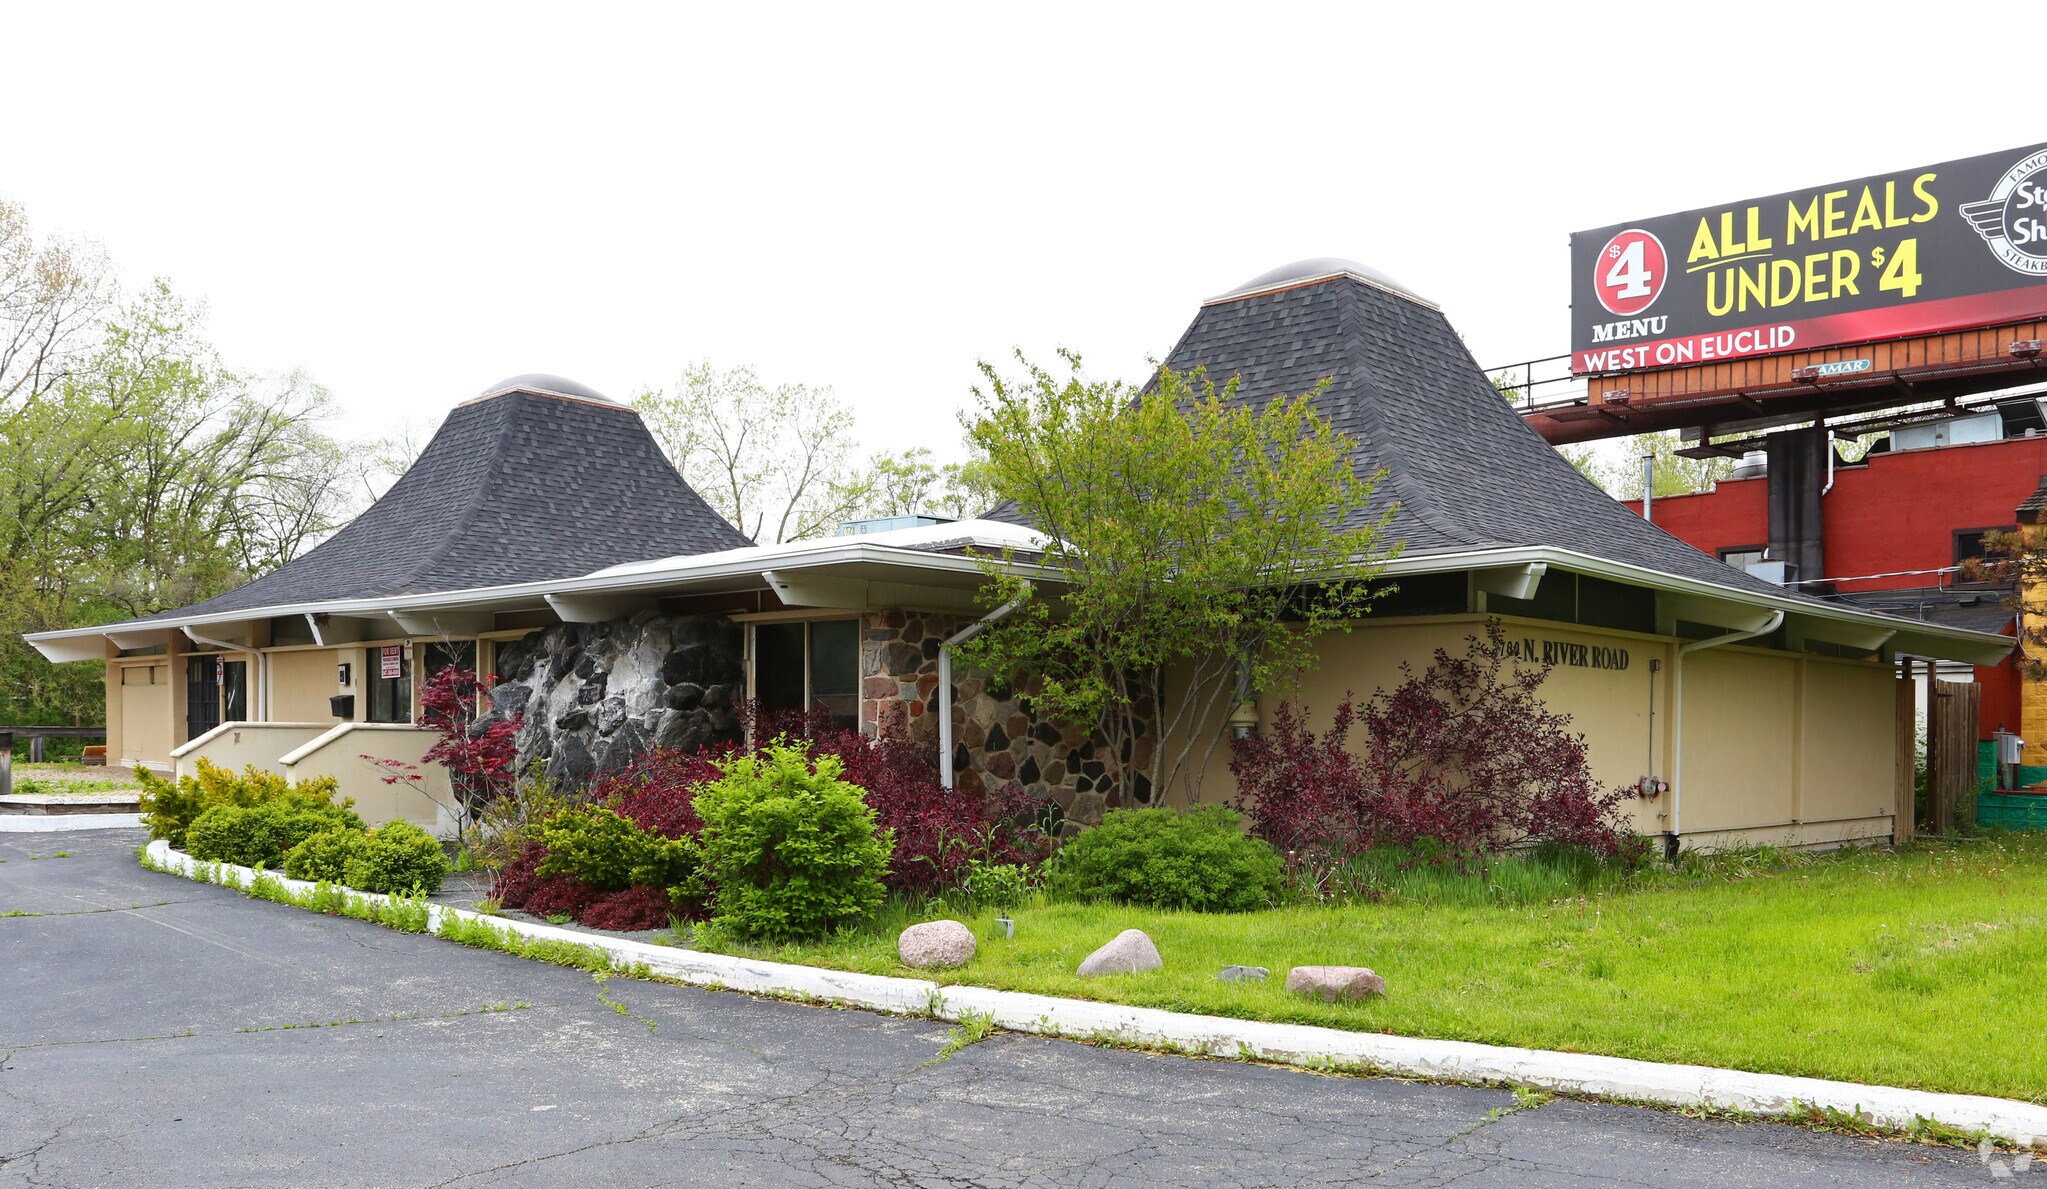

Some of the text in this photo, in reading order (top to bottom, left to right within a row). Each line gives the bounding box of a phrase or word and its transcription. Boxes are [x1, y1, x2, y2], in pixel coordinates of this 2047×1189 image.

[1687, 173, 1939, 263] ALL MEALS
[1706, 238, 1922, 317] UNDER $4
[1584, 325, 1795, 371] WEST ON EUCLID
[1592, 315, 1669, 343] MENU
[1814, 361, 1863, 375] AMAR
[1523, 639, 1538, 663] N.
[1543, 641, 1588, 667] RIVER
[1592, 646, 1629, 670] ROAD
